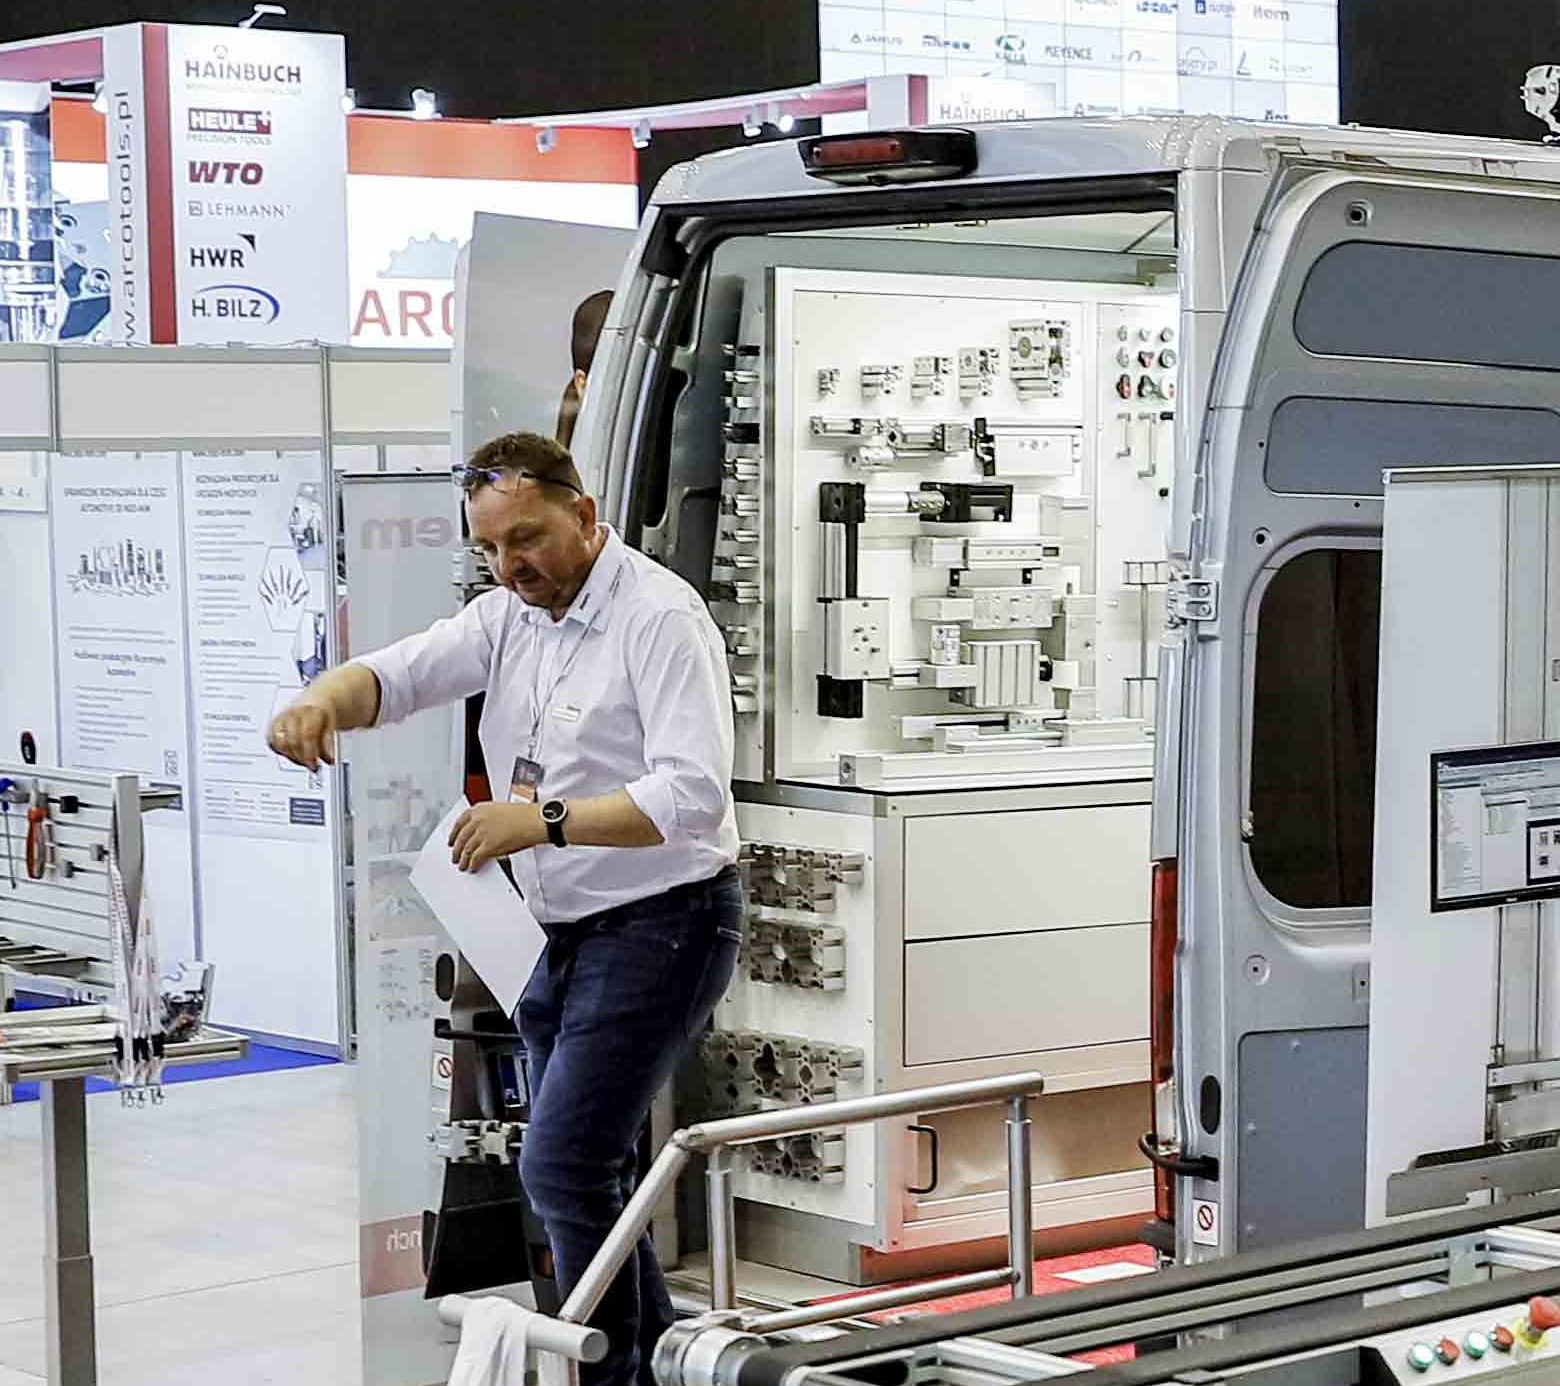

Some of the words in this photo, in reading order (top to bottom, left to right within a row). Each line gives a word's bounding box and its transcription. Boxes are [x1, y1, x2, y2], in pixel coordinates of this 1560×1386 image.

[185, 60, 301, 84] HAINBUCH
[191, 111, 258, 131] HEULE
[189, 161, 263, 184] WTO
[208, 202, 285, 217] LEHMANN
[190, 247, 245, 268] HWR
[191, 299, 211, 317] H.
[216, 299, 262, 317] BILZ
